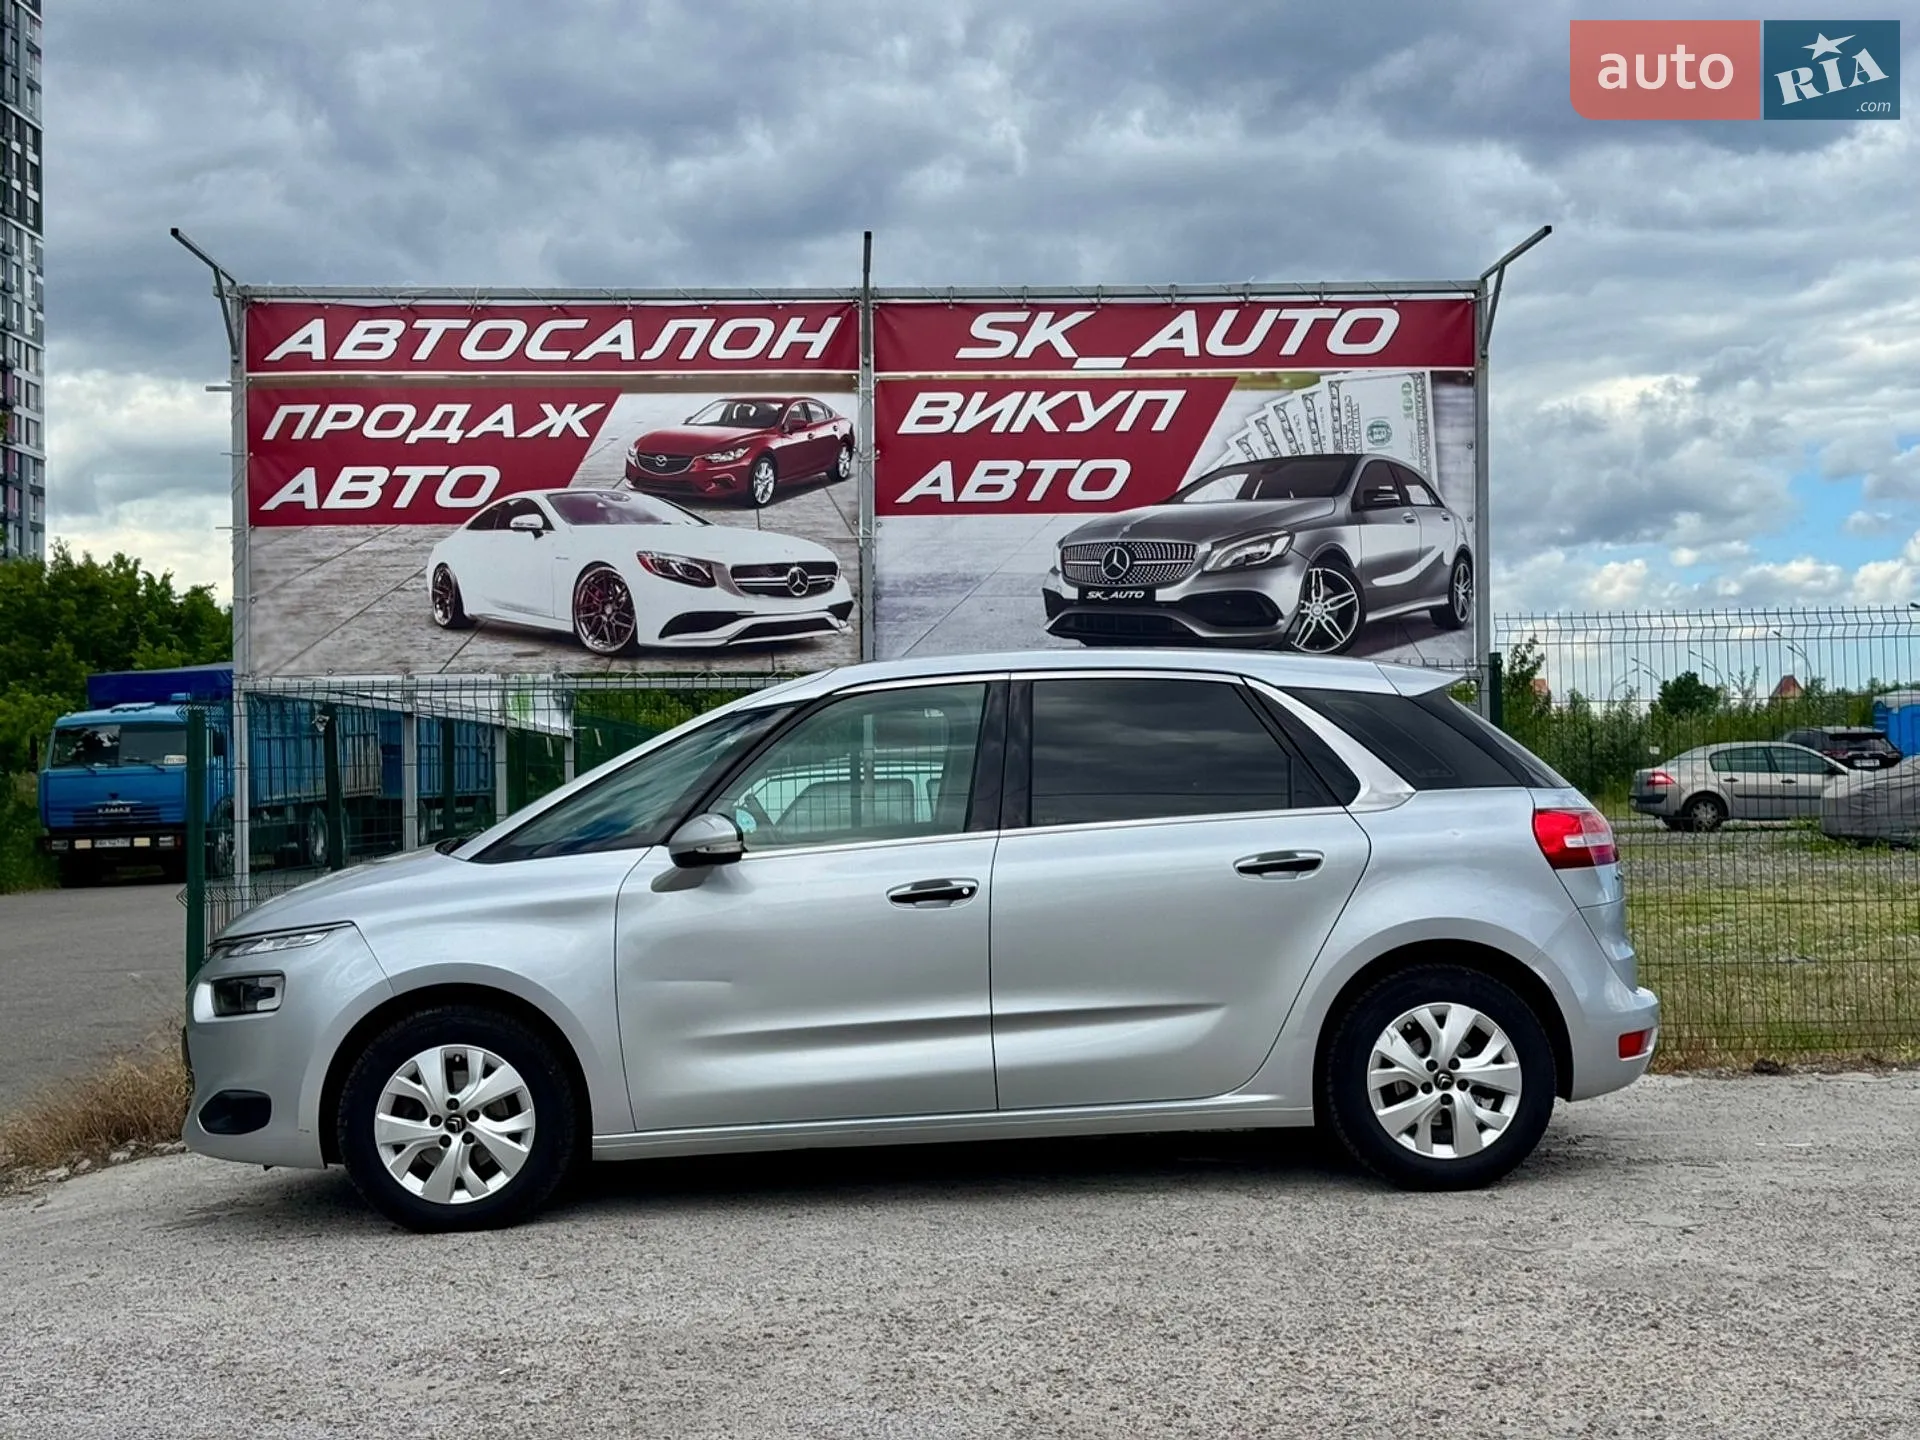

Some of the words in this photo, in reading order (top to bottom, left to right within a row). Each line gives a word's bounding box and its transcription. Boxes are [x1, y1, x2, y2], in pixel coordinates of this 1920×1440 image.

[265, 317, 842, 362] АВТОСАЛОН
[955, 307, 1401, 370] SK_AUTO
[262, 403, 607, 445] ПРОДАЖ
[897, 389, 1187, 435] ВИКУП
[260, 465, 501, 511] АВТО
[895, 458, 1132, 504] АВТО
[1086, 590, 1145, 600] SK_AUTO
